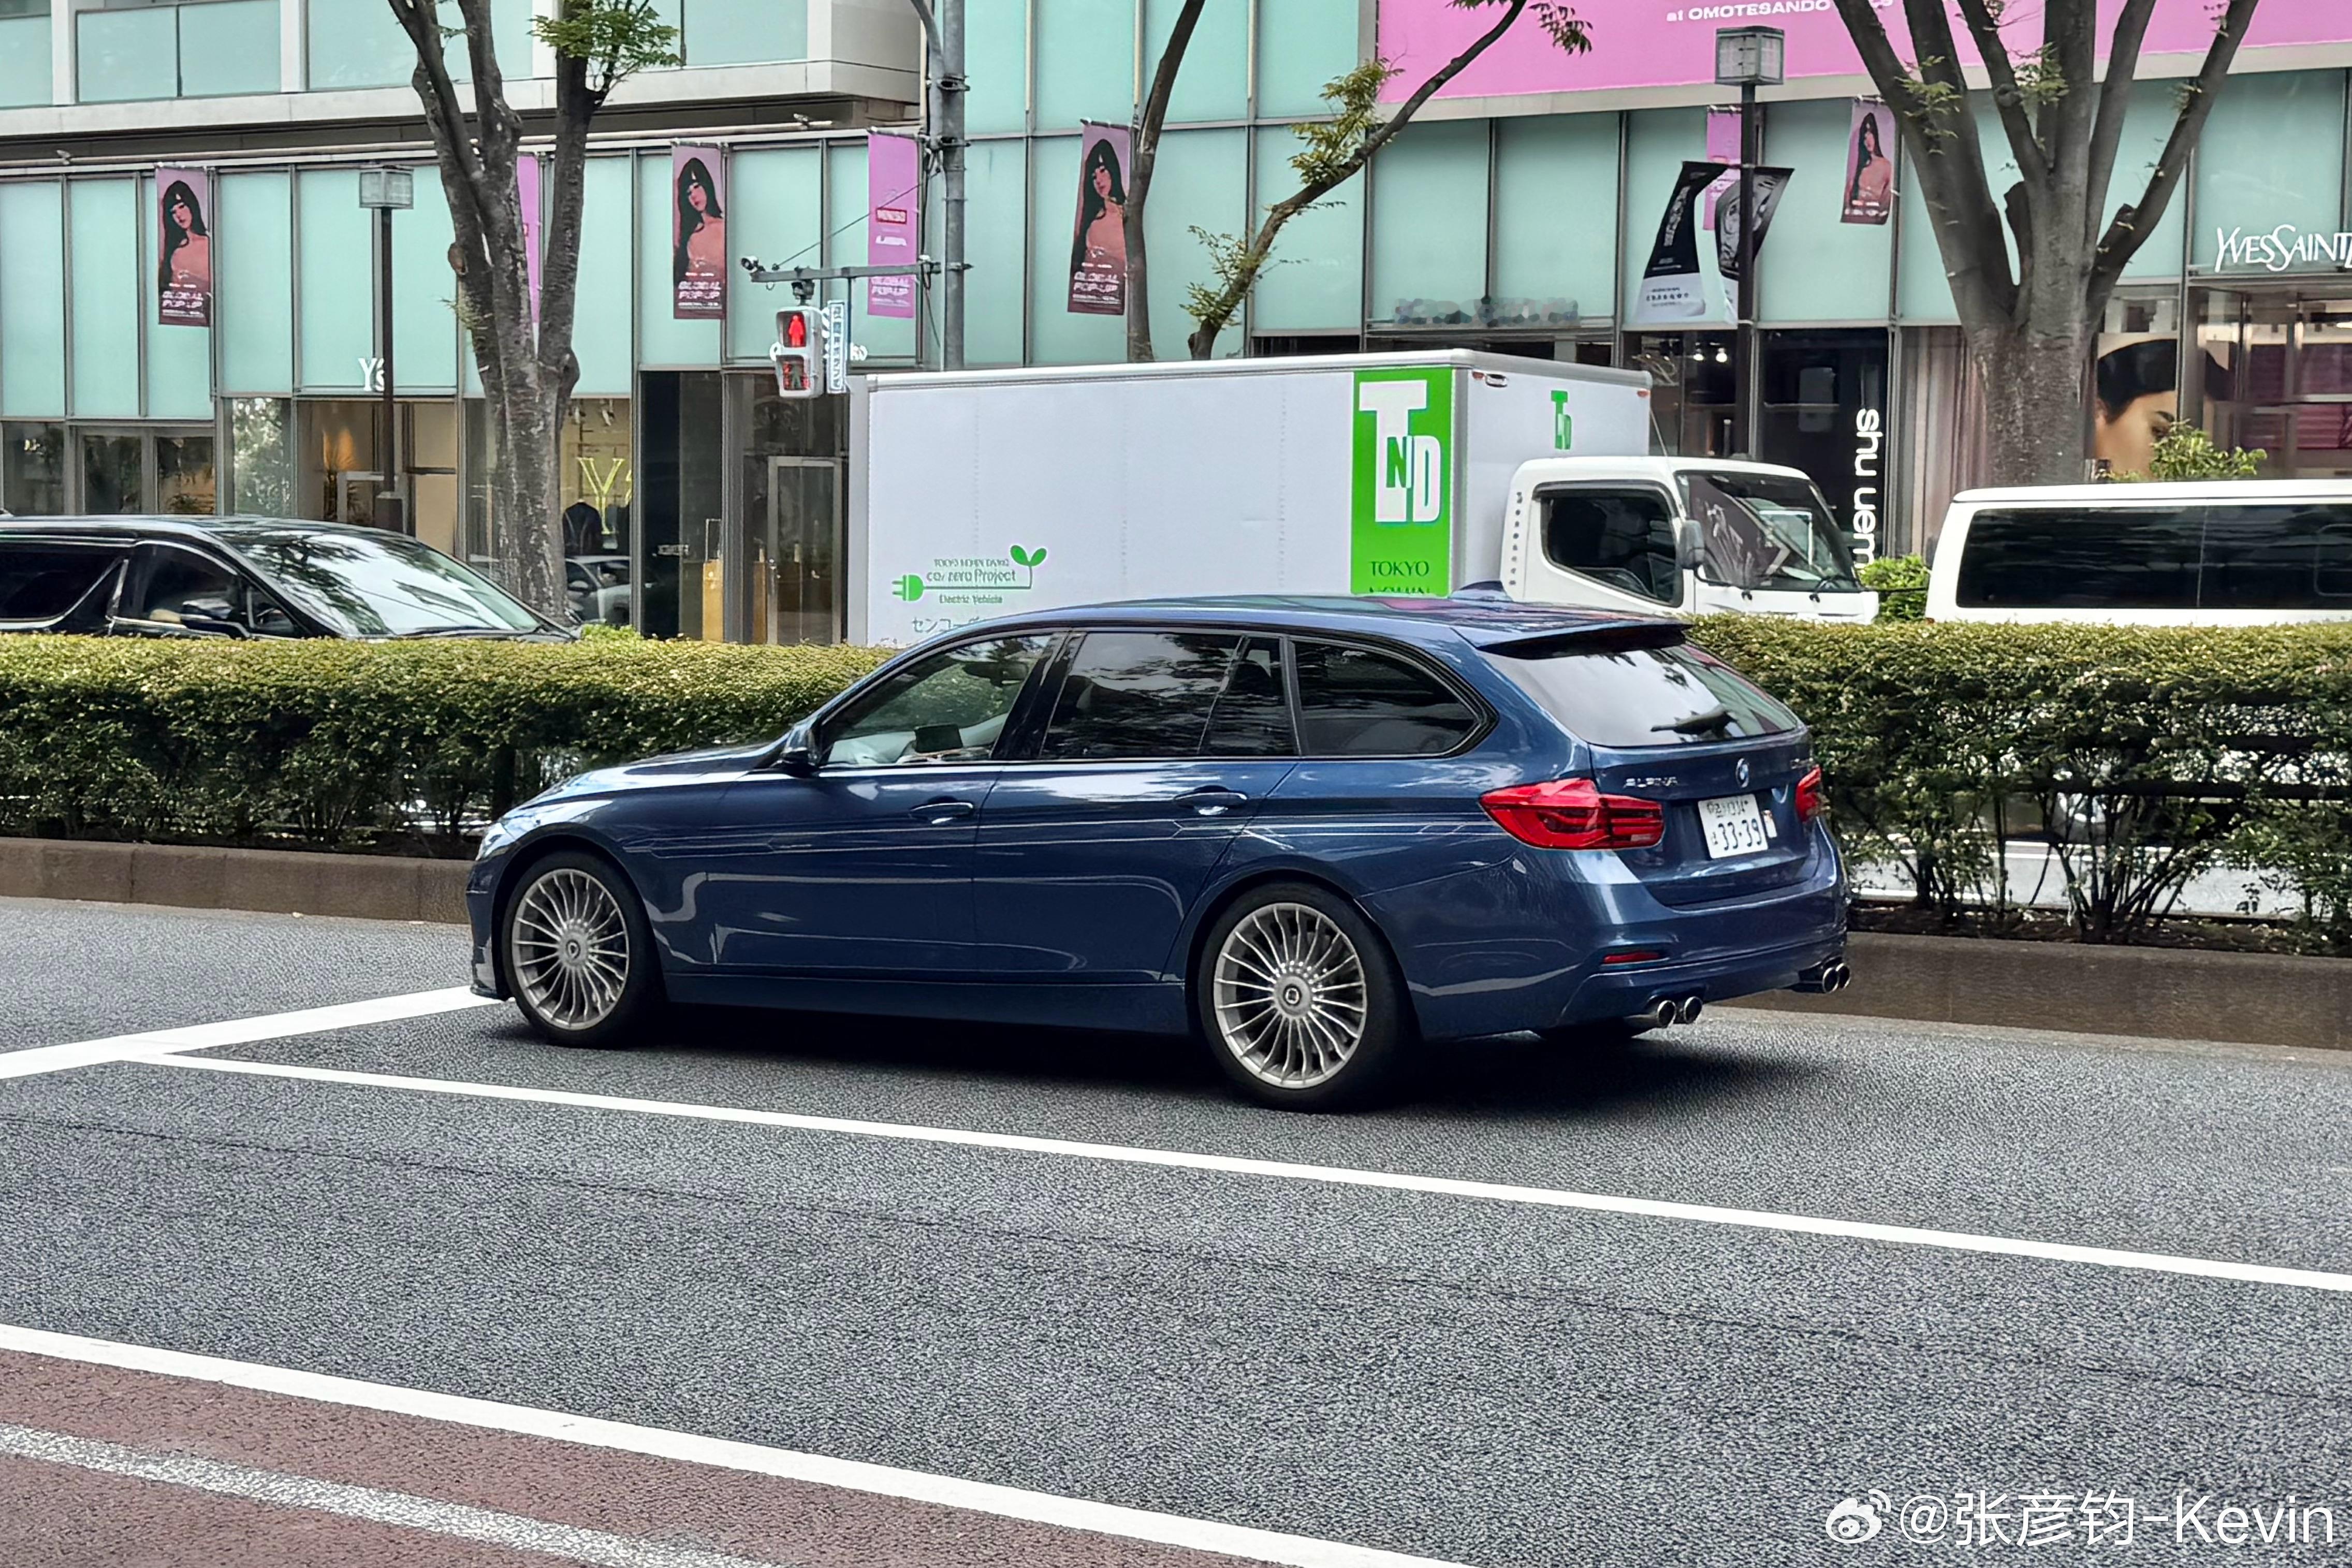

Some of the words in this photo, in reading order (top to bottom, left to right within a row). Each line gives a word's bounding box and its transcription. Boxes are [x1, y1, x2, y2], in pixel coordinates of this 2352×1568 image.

[1688, 0, 1831, 21] OMOTESANDO
[1854, 408, 1883, 477] shu
[948, 571, 972, 582] zero
[974, 569, 1016, 584] Project
[1369, 561, 1429, 576] TOKYO
